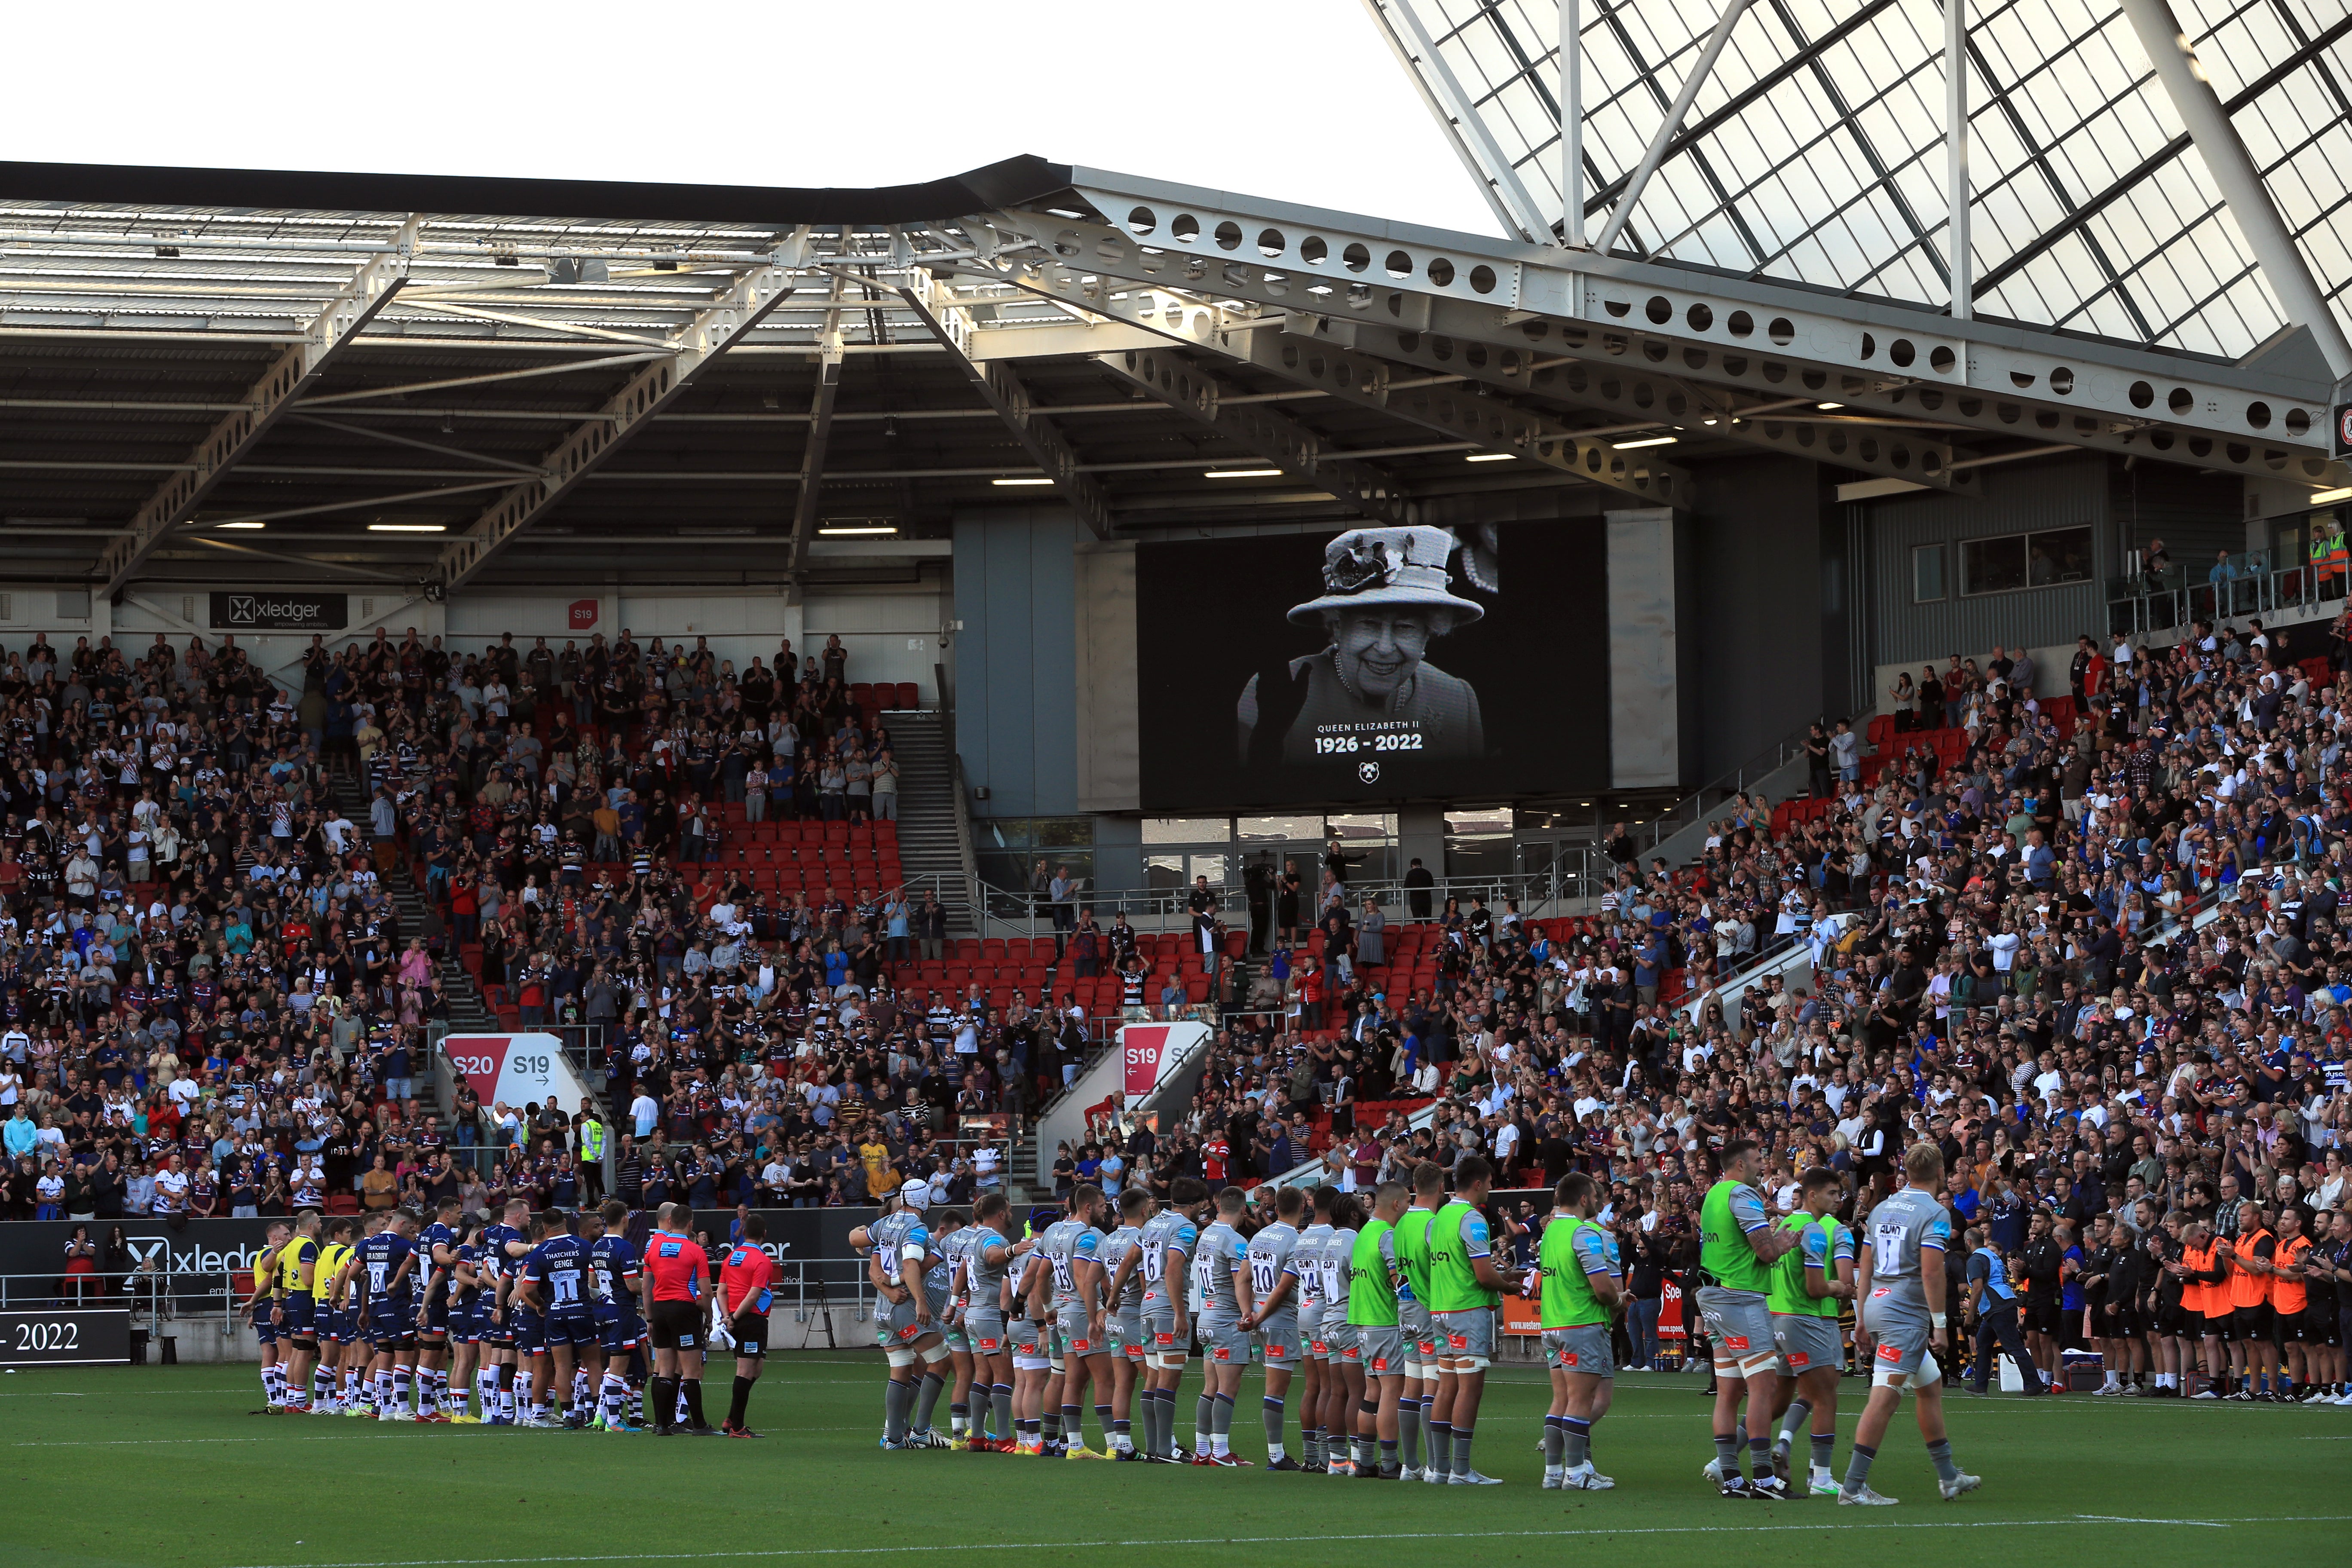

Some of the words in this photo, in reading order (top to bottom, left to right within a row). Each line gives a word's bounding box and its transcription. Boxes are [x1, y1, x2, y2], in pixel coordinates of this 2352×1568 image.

[256, 600, 320, 621] xledger
[575, 610, 592, 619] S19
[1317, 723, 1351, 733] QUEEN
[1355, 721, 1408, 731] ELIZABETH
[1315, 736, 1359, 753] 1926
[1375, 733, 1423, 751] 2022
[453, 1055, 494, 1075] S20
[513, 1055, 550, 1075] S19
[1126, 1047, 1157, 1065] S19
[1257, 1231, 1284, 1241] THATCHERS
[366, 1252, 389, 1260] BRADBURY
[545, 1250, 579, 1260] THATCHERS
[1252, 1240, 1277, 1253] FRANCIS
[554, 1259, 574, 1269] GENGE
[883, 1251, 893, 1276] 4
[1147, 1253, 1155, 1280] 6
[373, 1271, 380, 1292] 8
[1055, 1264, 1071, 1290] 13
[1199, 1266, 1214, 1294] 11
[1253, 1265, 1274, 1293] 10
[560, 1280, 572, 1302] 1
[1532, 1305, 1541, 1315] IND
[1510, 1321, 1541, 1331] www.western
[16, 1323, 79, 1351] 2022
